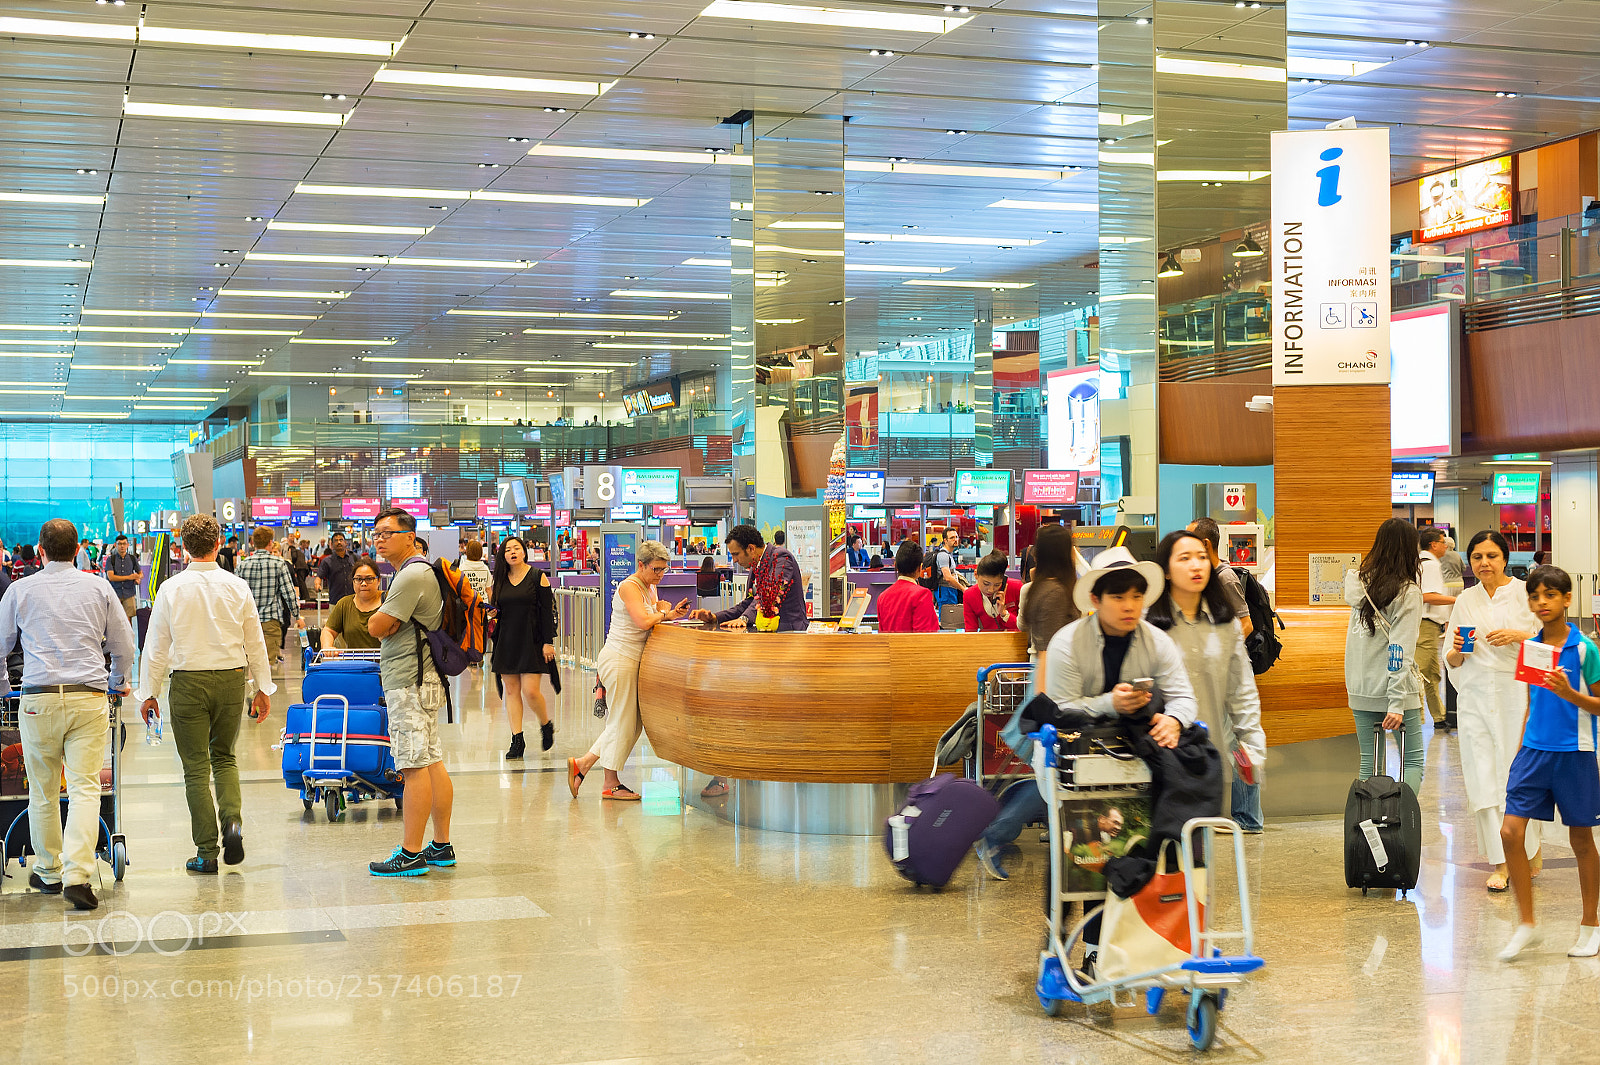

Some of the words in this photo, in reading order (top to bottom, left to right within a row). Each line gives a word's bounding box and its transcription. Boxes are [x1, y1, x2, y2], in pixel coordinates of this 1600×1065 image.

[1423, 223, 1453, 239] Authentic
[1454, 219, 1484, 233] Japanese
[1485, 213, 1509, 225] Cuisine
[1328, 278, 1377, 287] INFORMASI
[1284, 222, 1303, 374] INFORMATION
[1337, 361, 1376, 369] CHANGI
[498, 483, 509, 509] 7
[597, 472, 615, 501] 8
[167, 512, 178, 527] 4
[222, 501, 236, 520] 6
[137, 520, 146, 533] 2
